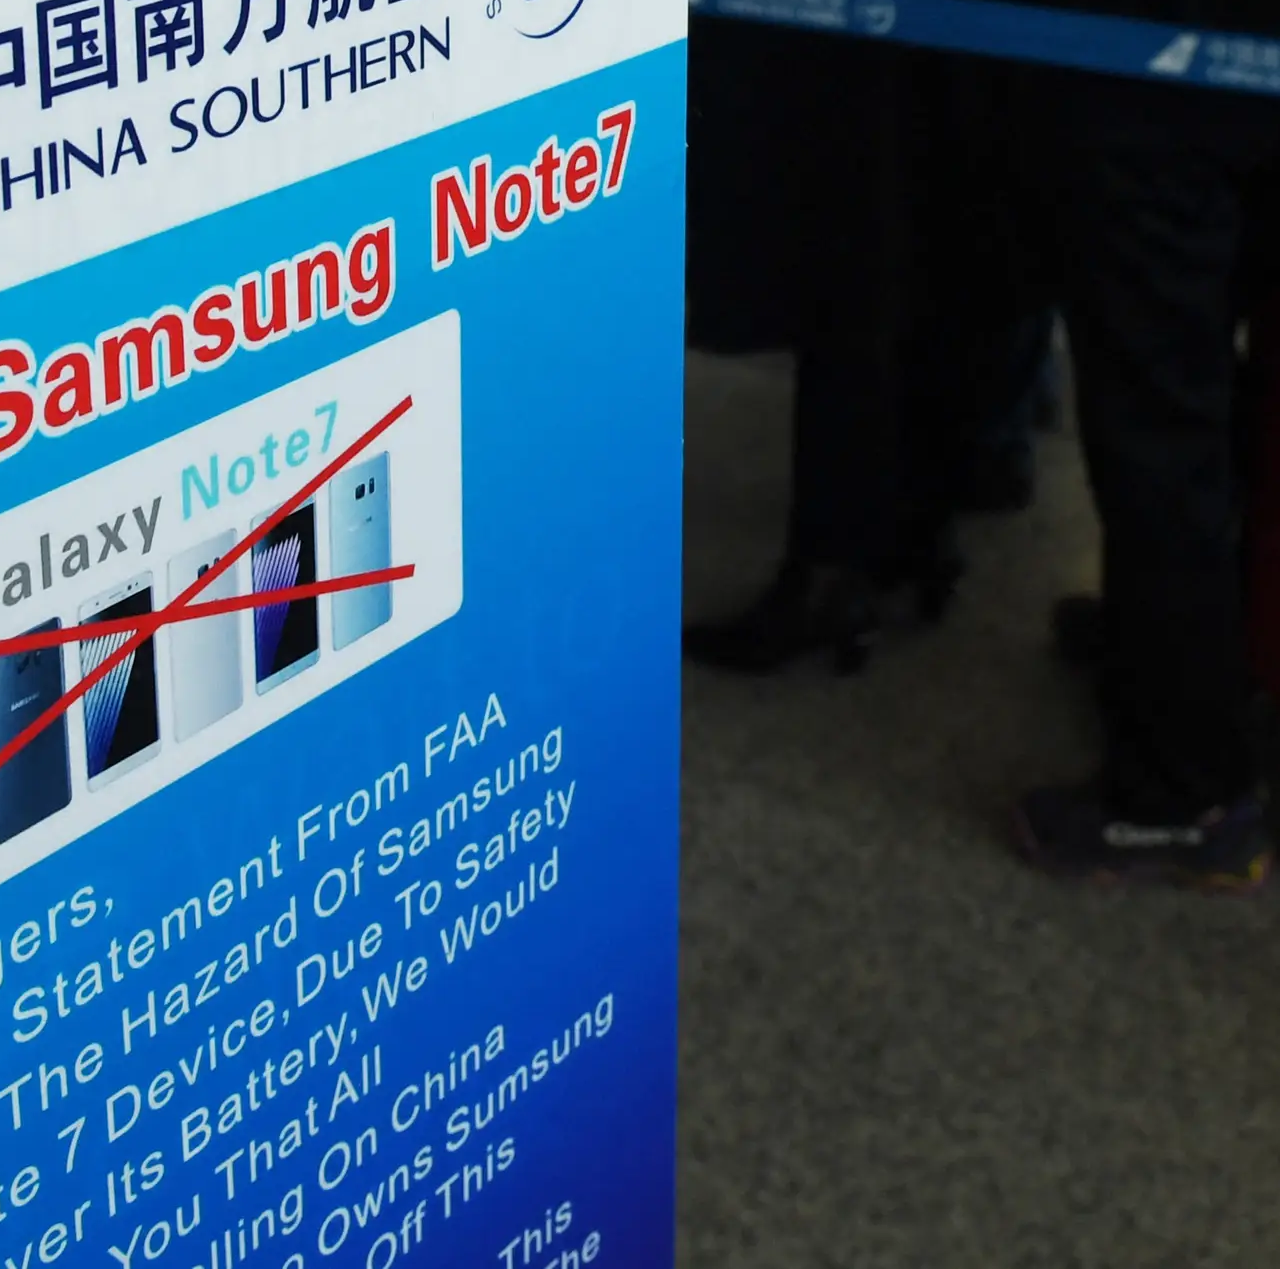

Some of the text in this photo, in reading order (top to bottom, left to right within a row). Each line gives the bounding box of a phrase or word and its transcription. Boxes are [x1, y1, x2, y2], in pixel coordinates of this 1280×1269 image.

[170, 16, 452, 153] SOUTHERN
[430, 106, 635, 265] Note7
[180, 400, 339, 521] Note7
[12, 835, 284, 1044] Statement
[297, 761, 410, 862] From
[424, 692, 507, 778] FAA
[57, 1116, 86, 1174] 7
[394, 879, 443, 931] To
[454, 780, 576, 890] Safety
[121, 895, 298, 1056] Hazard
[313, 848, 366, 918] Of
[377, 725, 563, 877] Samsung
[106, 1151, 165, 1218] Its
[439, 845, 559, 965] Would
[191, 1024, 505, 1269] lling On China
[317, 992, 614, 1256] Owns Sumsung
[107, 1044, 382, 1269] You That All
[365, 1137, 516, 1269] Off This
[497, 1200, 573, 1269] This
